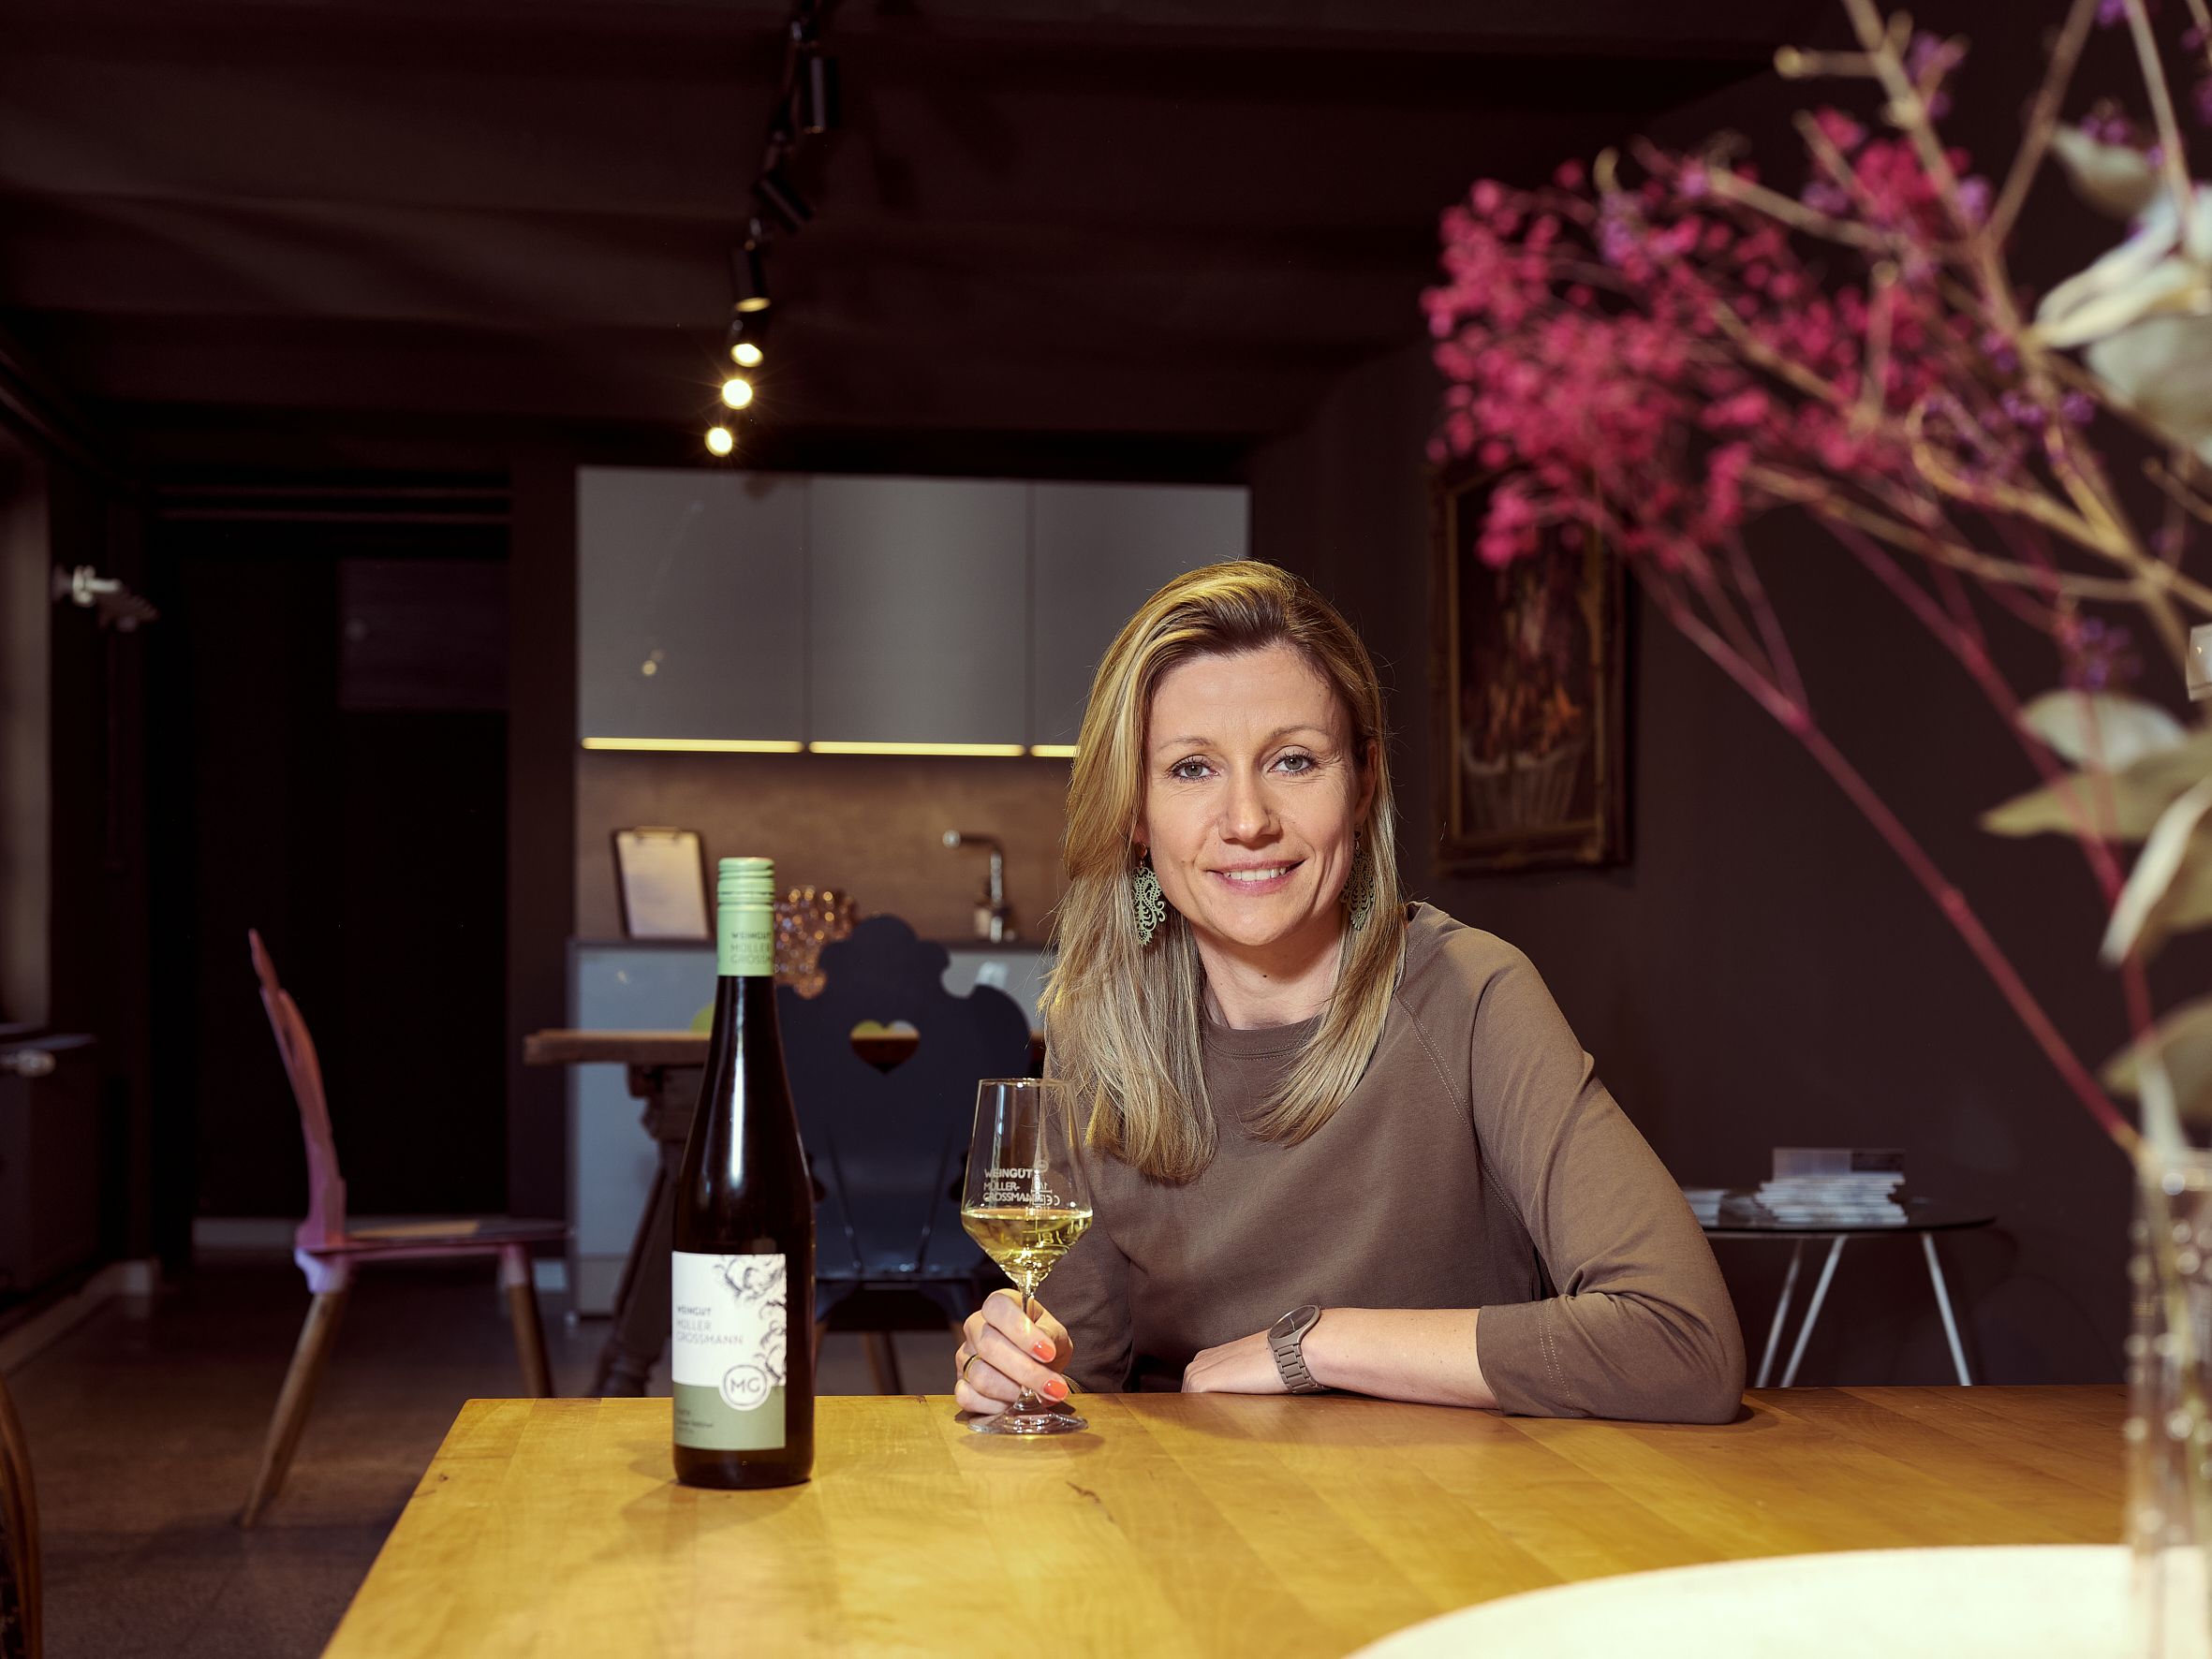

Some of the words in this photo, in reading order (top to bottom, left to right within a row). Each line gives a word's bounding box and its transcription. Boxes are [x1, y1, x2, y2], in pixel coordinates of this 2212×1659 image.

[984, 1167, 1032, 1179] WEINGUT
[676, 1304, 712, 1316] WEINGUT
[730, 1377, 760, 1393] MG
